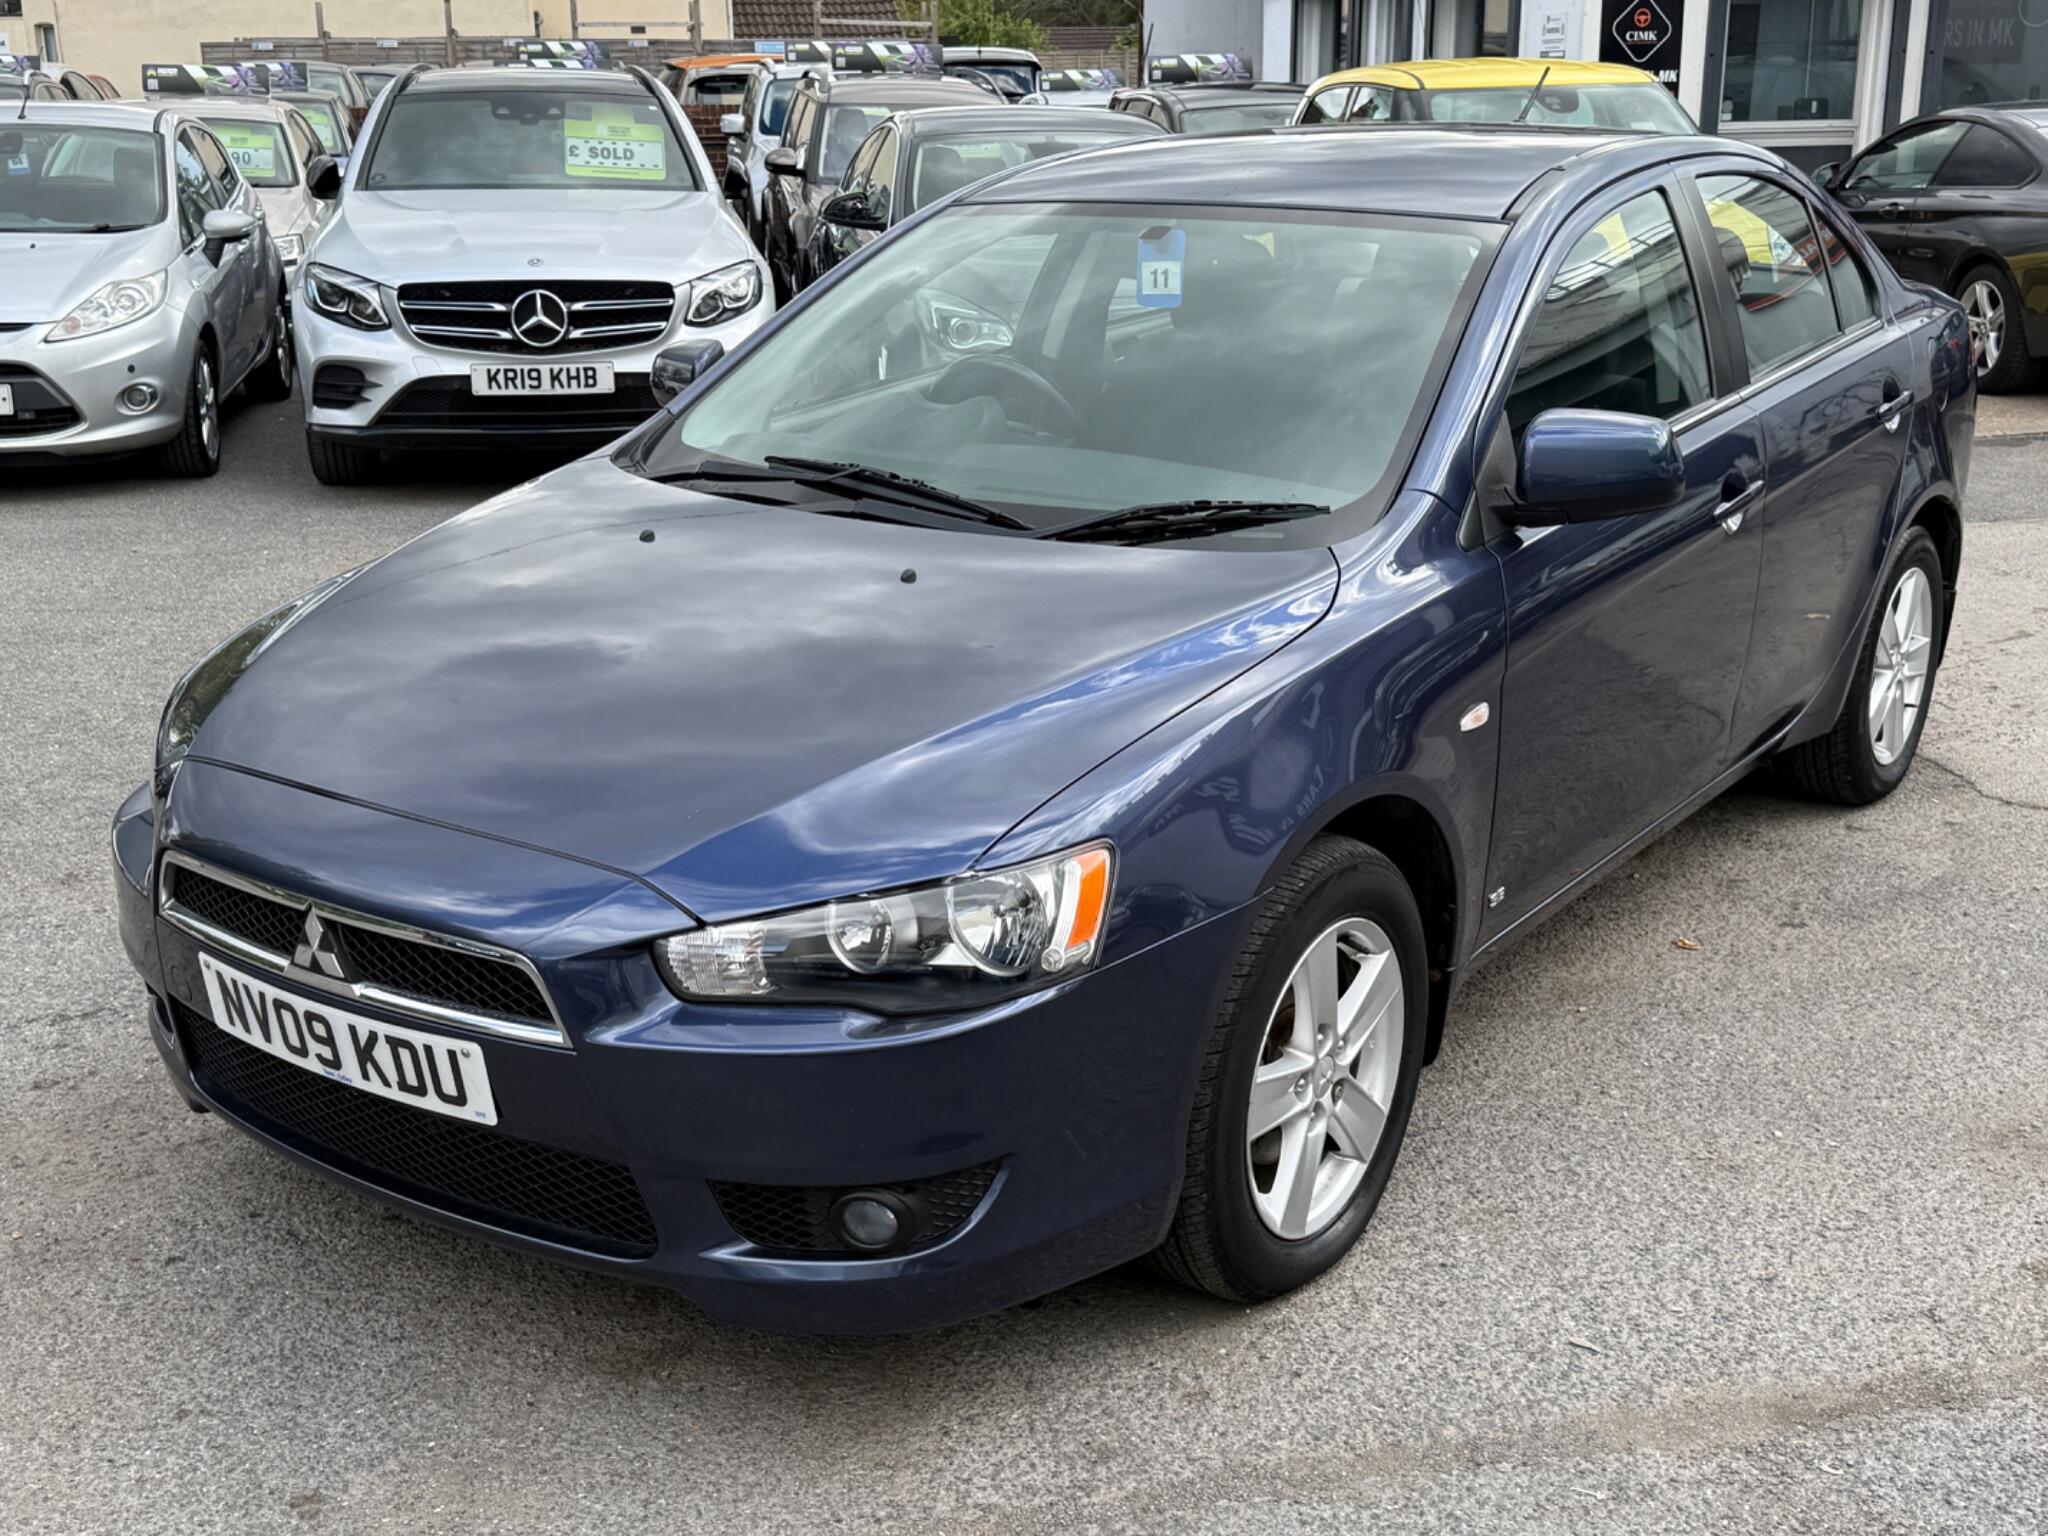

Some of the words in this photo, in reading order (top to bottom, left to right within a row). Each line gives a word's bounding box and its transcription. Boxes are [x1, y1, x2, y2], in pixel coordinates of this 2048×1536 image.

[1625, 30, 1658, 41] CIMK
[1988, 17, 2015, 47] MK
[568, 144, 580, 158] £
[588, 146, 635, 161] SOLD
[1150, 268, 1169, 288] 11
[486, 367, 542, 390] KR19
[549, 366, 598, 389] KHB
[216, 969, 342, 1071] NV09
[347, 1022, 468, 1107] KDU
